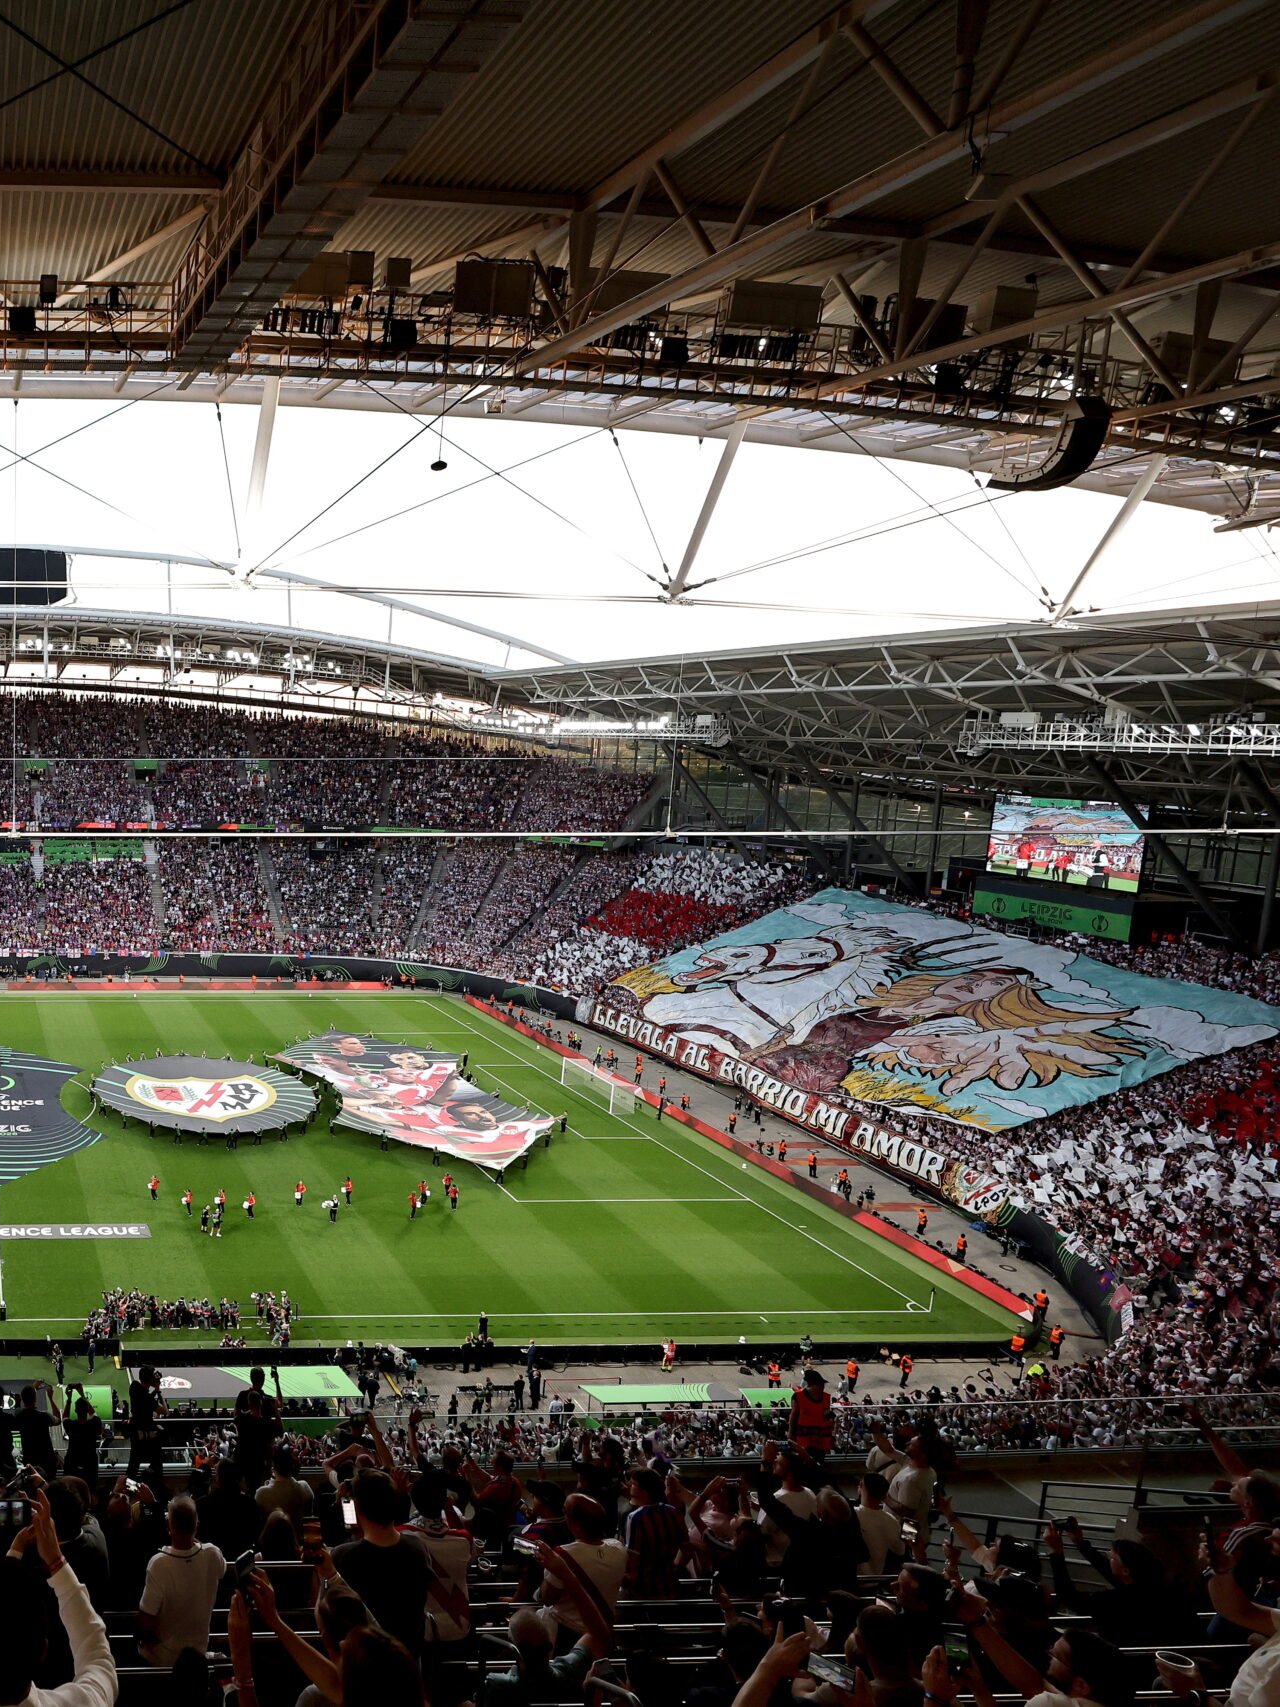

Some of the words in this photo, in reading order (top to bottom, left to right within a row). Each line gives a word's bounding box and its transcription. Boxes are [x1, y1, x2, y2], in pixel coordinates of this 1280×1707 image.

[1021, 902, 1073, 920] LEIPZIG
[592, 1005, 679, 1058] LLEVALA
[681, 1043, 711, 1073] AL
[718, 1056, 809, 1123] BARRIO,
[809, 1101, 850, 1139] MI
[851, 1121, 949, 1188] AMOR
